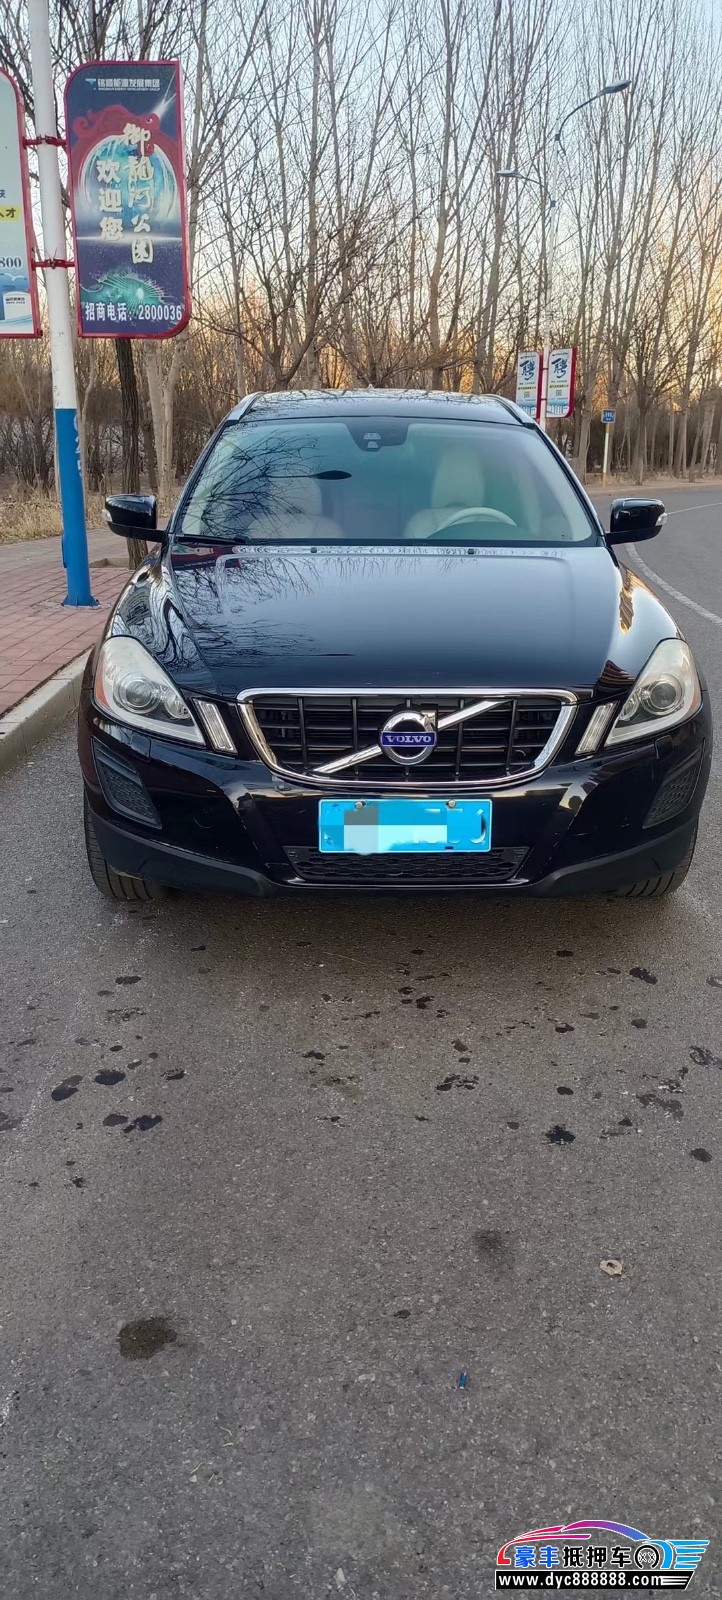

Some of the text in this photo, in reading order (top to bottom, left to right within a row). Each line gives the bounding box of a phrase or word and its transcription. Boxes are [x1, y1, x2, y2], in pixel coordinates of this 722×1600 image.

[96, 160, 124, 241] 欢迎您
[385, 735, 432, 743] VOLVO
